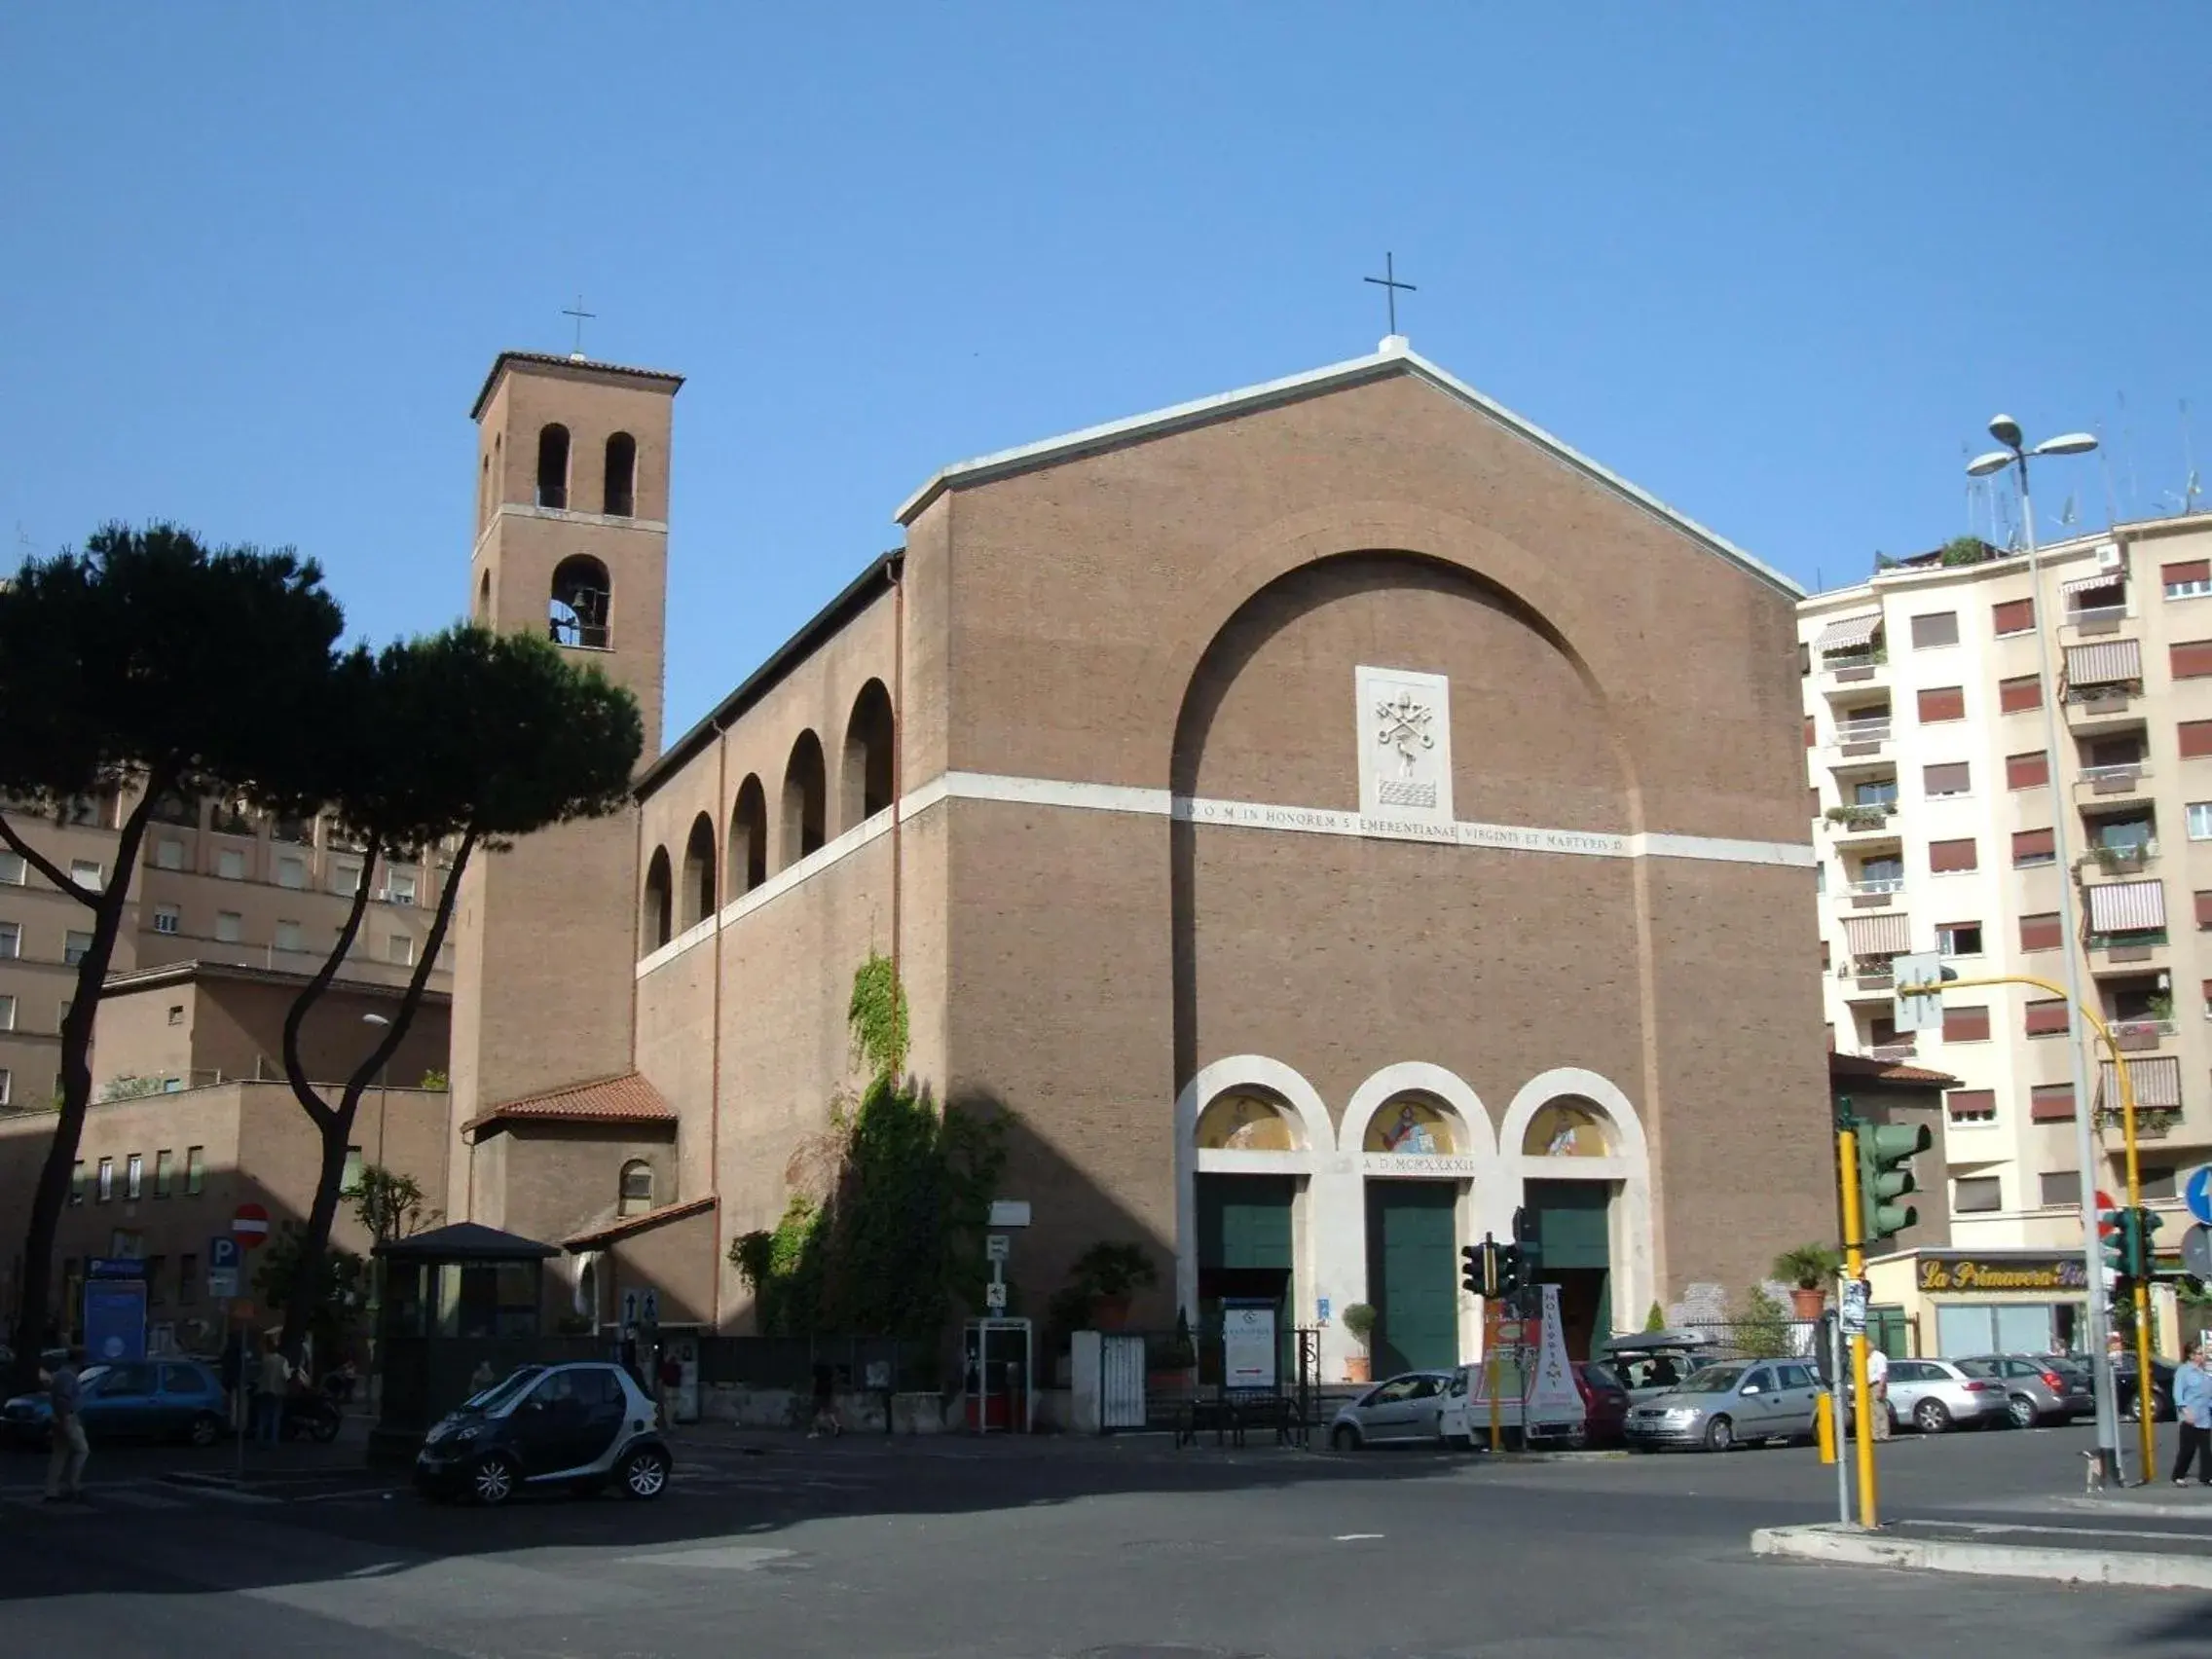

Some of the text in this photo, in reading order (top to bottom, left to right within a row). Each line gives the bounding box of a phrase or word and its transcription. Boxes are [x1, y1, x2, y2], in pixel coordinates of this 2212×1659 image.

[1243, 808, 1259, 820] IN
[1266, 809, 1337, 827] HONOREM
[1359, 818, 1456, 836] EMERENTIANAE
[1464, 828, 1520, 844] VIRGINIS
[1526, 833, 1540, 845] ET
[1546, 834, 1611, 850] MARTYRIS
[214, 1239, 234, 1265] P
[1921, 1260, 1951, 1288] La
[1951, 1261, 2051, 1288] Primavera
